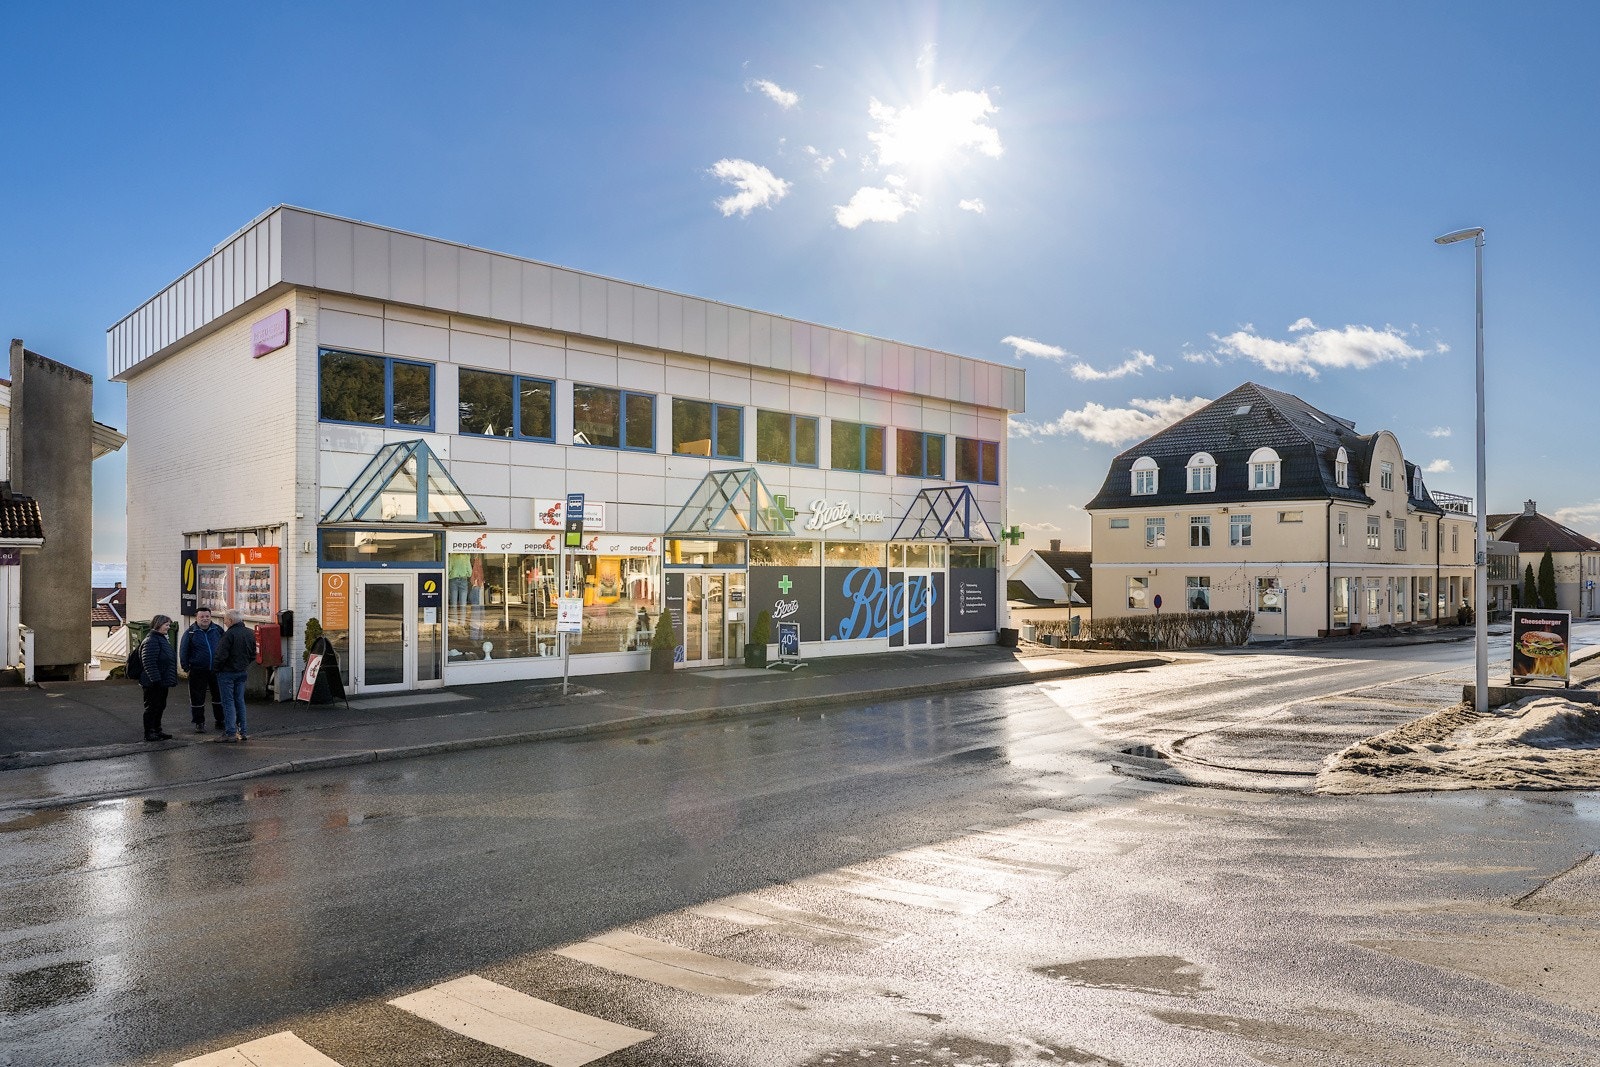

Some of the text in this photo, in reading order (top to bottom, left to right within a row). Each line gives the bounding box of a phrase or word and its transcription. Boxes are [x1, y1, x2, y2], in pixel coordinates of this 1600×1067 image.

[804, 499, 885, 531] Boots Apotek
[772, 600, 799, 619] Boots
[1520, 618, 1562, 626] Cheeseburger
[781, 633, 798, 645] 40%
